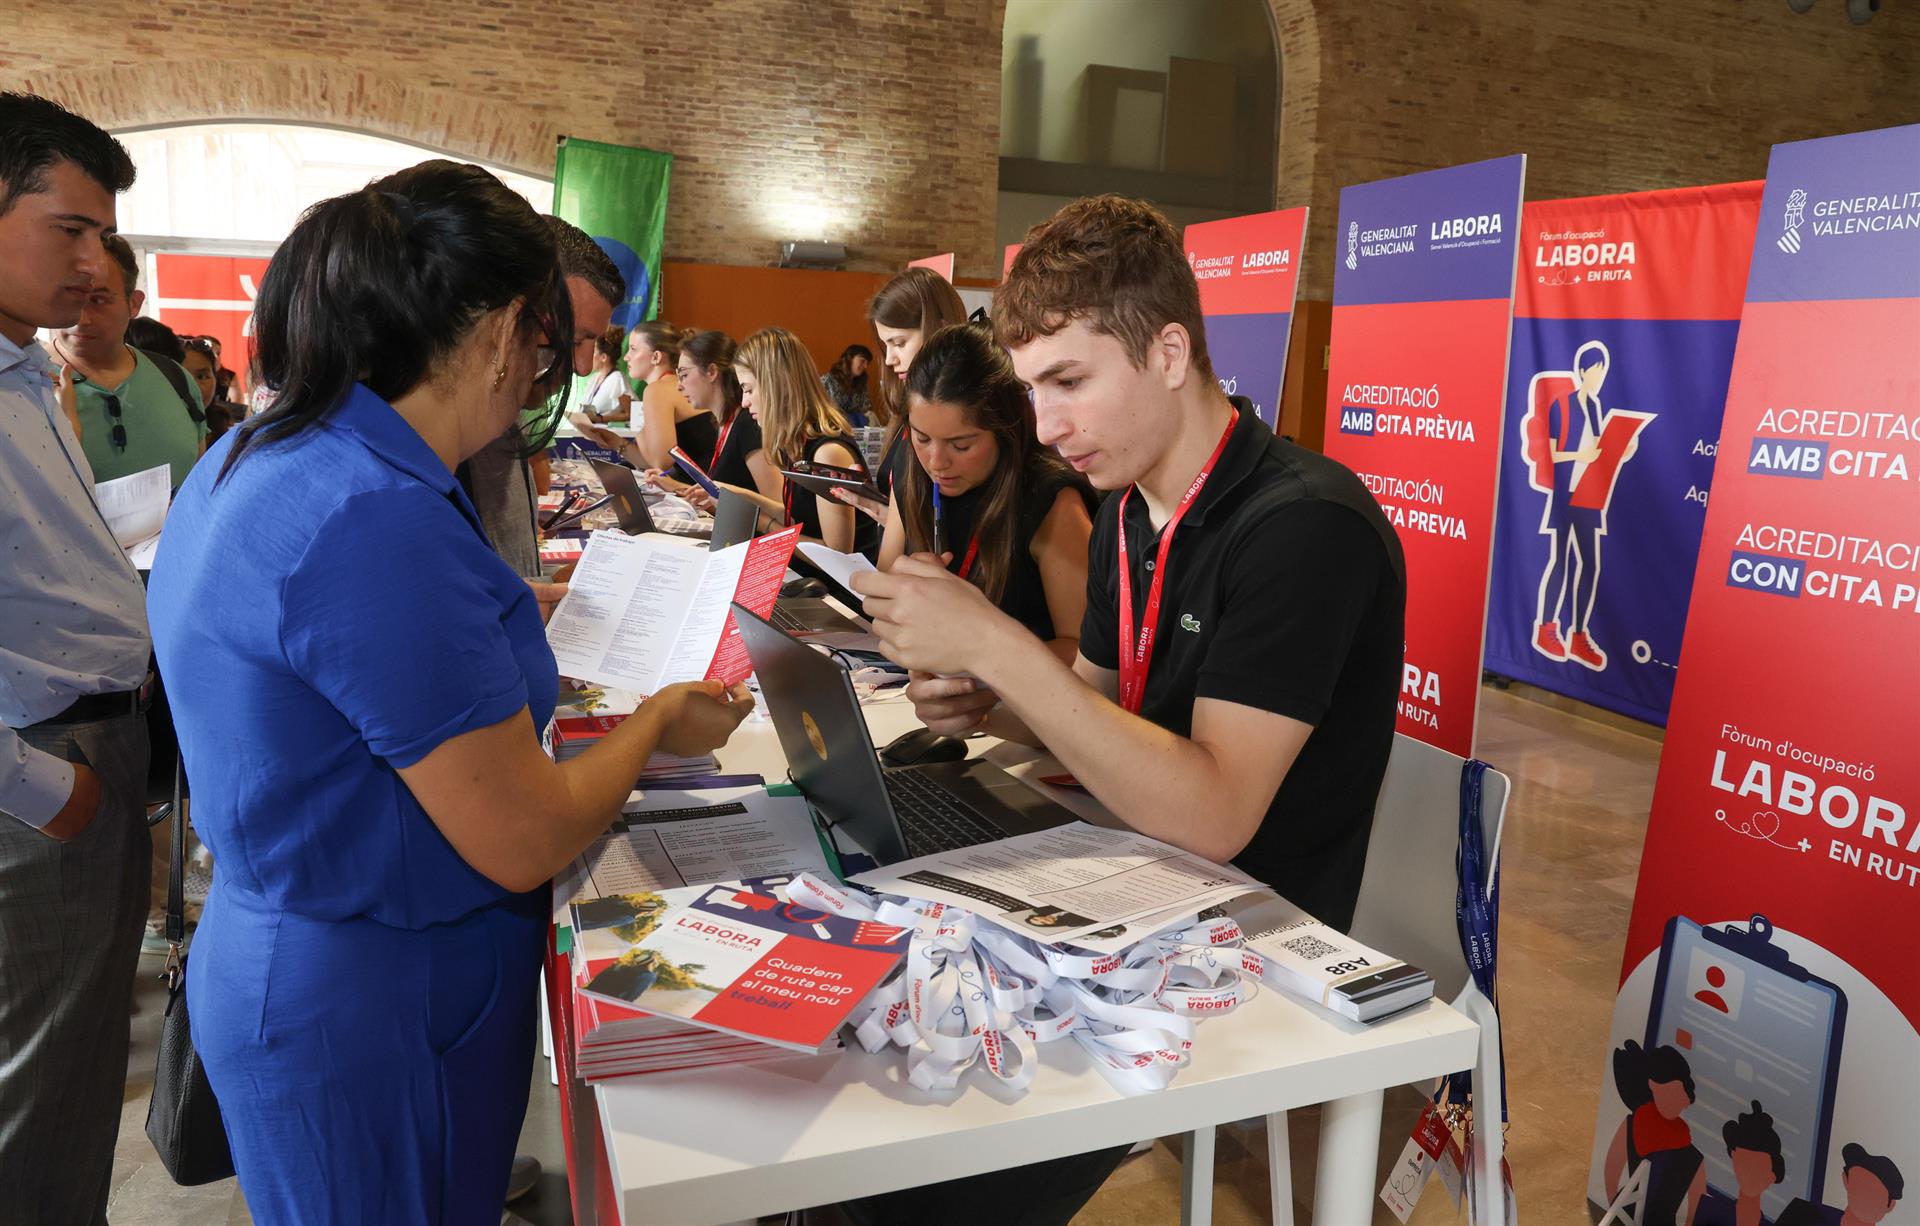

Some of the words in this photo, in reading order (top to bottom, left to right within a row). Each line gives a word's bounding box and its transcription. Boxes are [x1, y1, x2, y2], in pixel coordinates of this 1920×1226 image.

[1360, 224, 1418, 242] GENERALITAT
[1431, 214, 1502, 240] LABORA
[1242, 250, 1289, 268] LABORA
[1360, 240, 1414, 256] VALENCIANA
[1536, 242, 1636, 267] LABORA
[1196, 256, 1234, 269] GENERALITAT
[1587, 271, 1600, 282] EN
[1602, 270, 1632, 280] RUTA
[1342, 384, 1439, 408] ACREDITACIÓ
[1341, 410, 1373, 432] AMB
[1376, 417, 1412, 436] CITA
[1415, 414, 1475, 442] PRÈVIA
[1750, 444, 1820, 472] AMB
[1829, 450, 1908, 480] CITA
[1182, 472, 1208, 504] LABORA
[1408, 510, 1466, 540] PREVIA
[1730, 558, 1798, 592] CON
[1805, 570, 1883, 607] CITA
[1136, 626, 1150, 662] LABORA
[1406, 703, 1438, 730] RUTA
[1721, 724, 1772, 752] Fòrum
[1828, 840, 1862, 867] EN
[676, 918, 762, 946] LABORA
[1470, 936, 1482, 970] LABORA
[1482, 932, 1492, 964] LABORA
[768, 958, 842, 980] Quadern
[1324, 956, 1371, 976] A88
[741, 980, 762, 989] al
[760, 985, 801, 999] meu
[804, 993, 841, 1006] nou
[754, 969, 778, 980] de
[780, 976, 816, 988] ruta
[819, 984, 853, 996] cap
[730, 990, 792, 1010] treball
[1187, 996, 1236, 1010] LABORA
